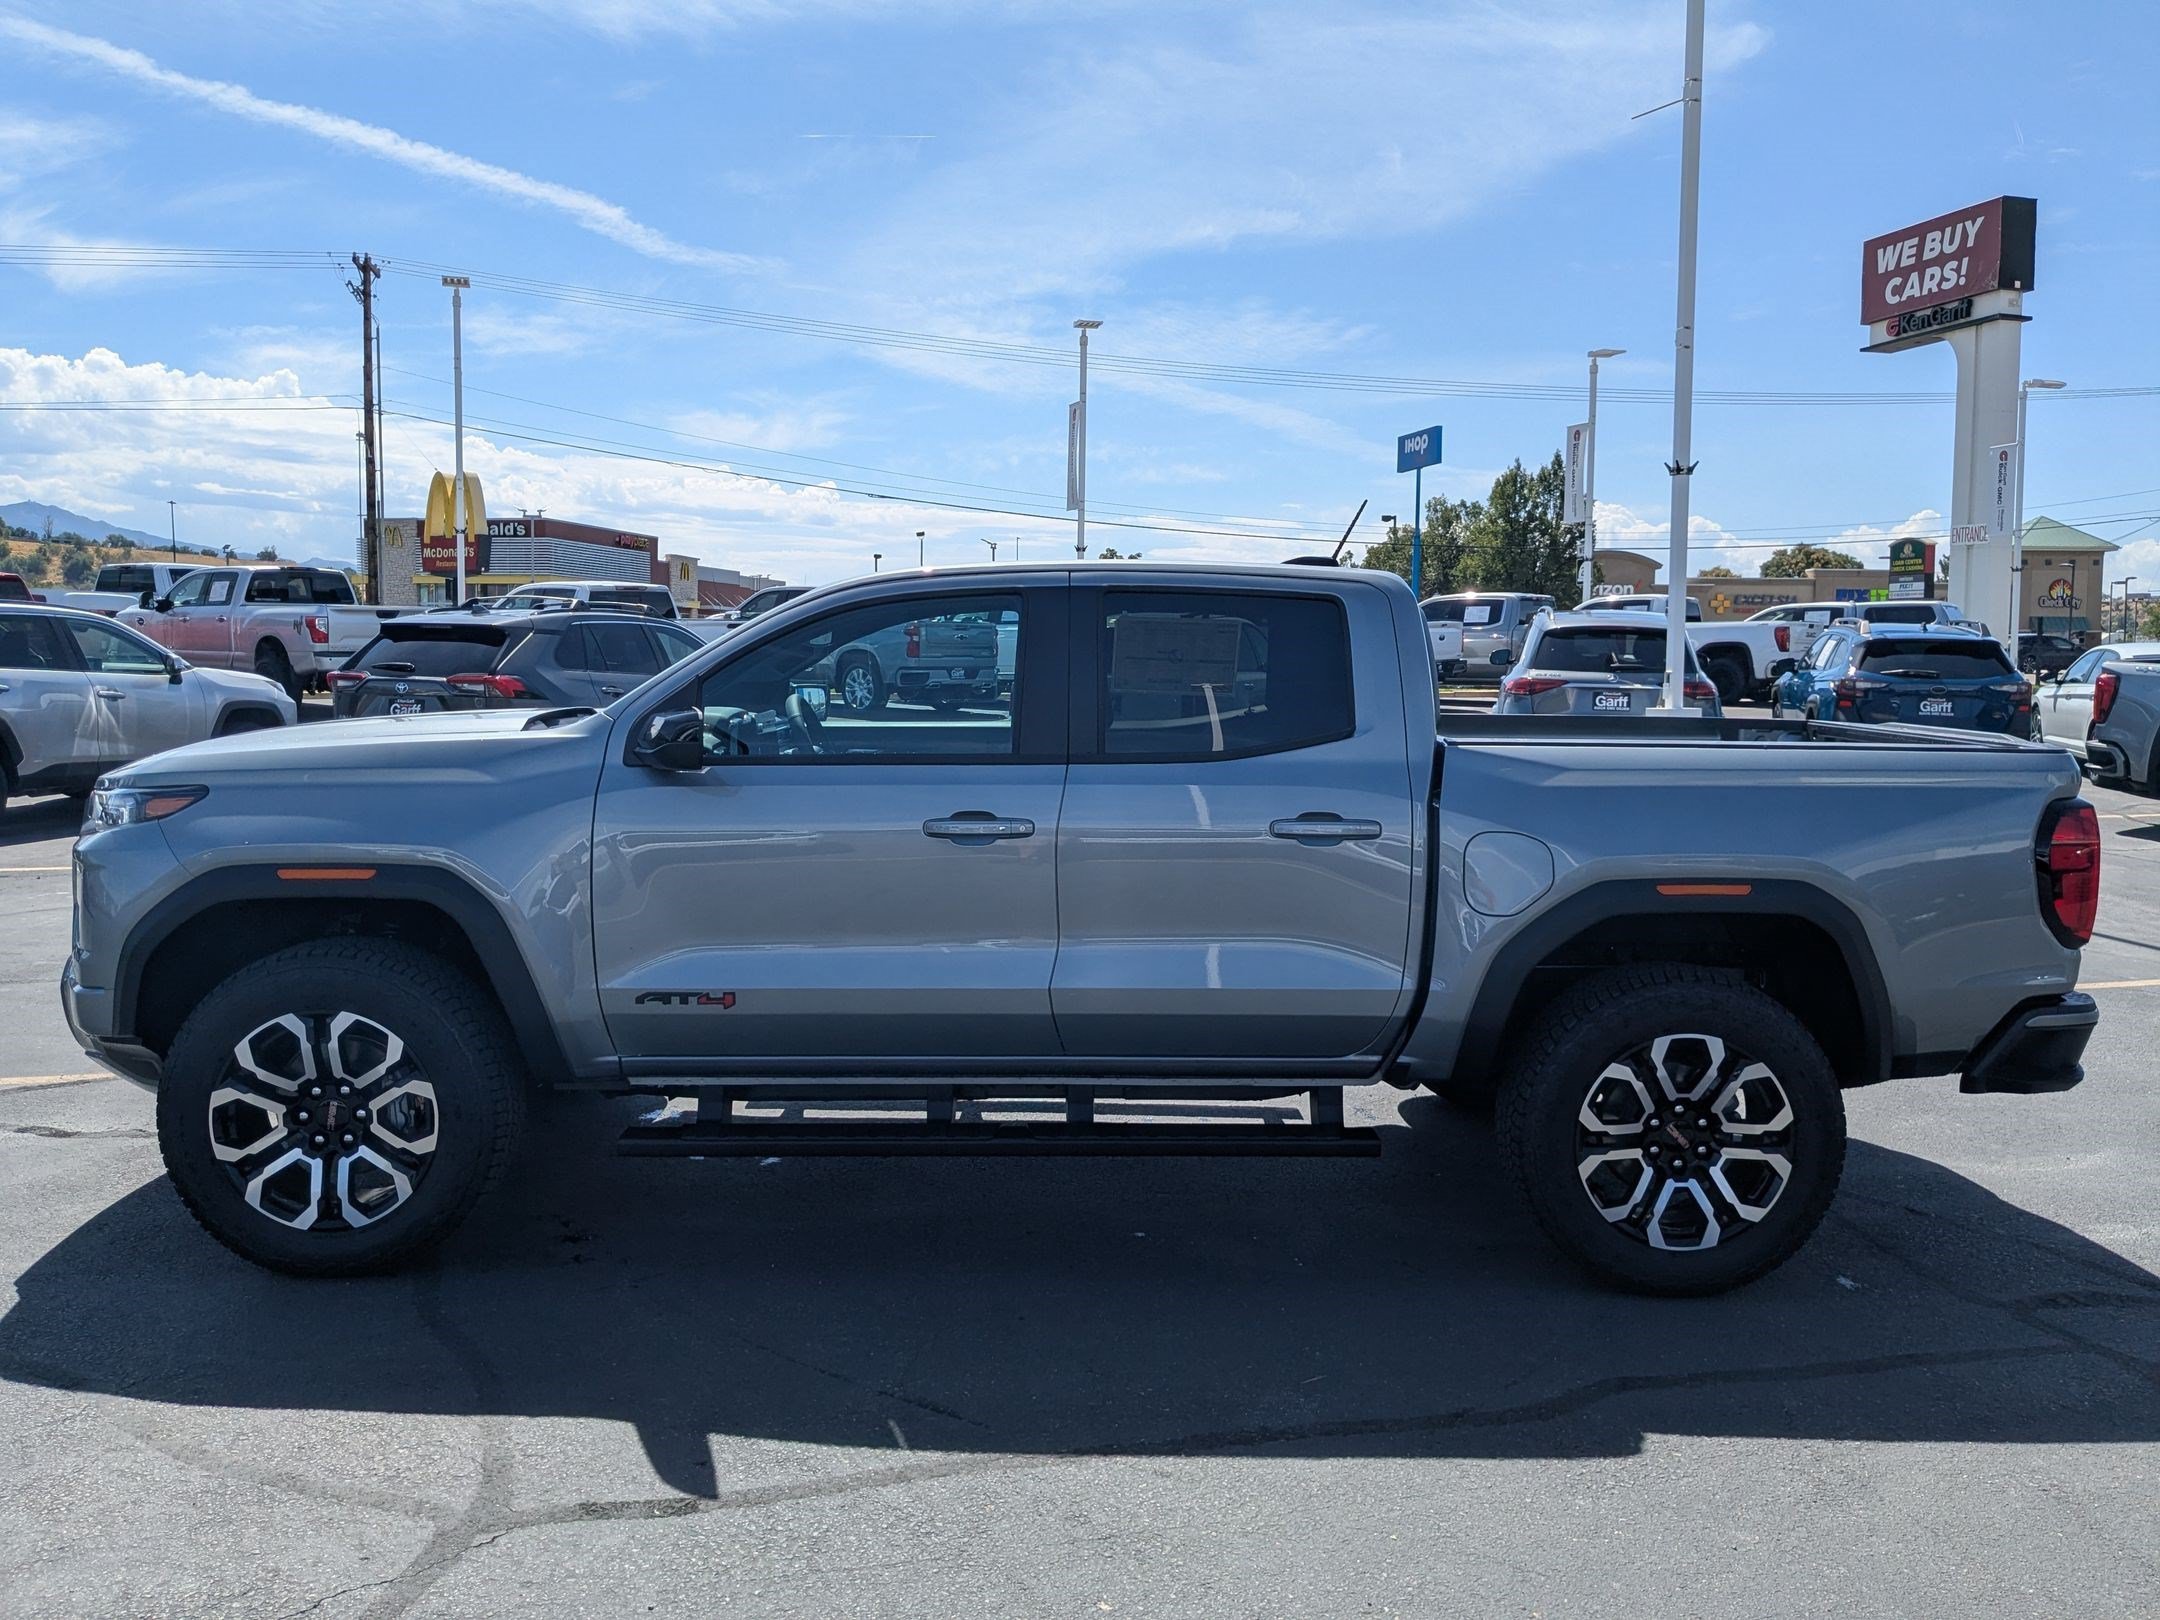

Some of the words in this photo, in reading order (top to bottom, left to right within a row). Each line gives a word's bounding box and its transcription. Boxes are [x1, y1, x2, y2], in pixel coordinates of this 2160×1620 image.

[1877, 237, 1920, 274] WE
[1923, 216, 1985, 260] BUY
[1885, 257, 1969, 304] CARS!
[1900, 314, 1928, 334] Ken
[1404, 433, 1429, 455] IHOP
[489, 522, 526, 536] ald's
[1952, 525, 1988, 544] ENTRANCE
[423, 547, 475, 558] McDond's
[1593, 583, 1634, 596] rizon
[1595, 695, 1629, 707] Garff
[1920, 700, 1952, 712] Garff
[390, 703, 421, 716] Garff
[635, 992, 736, 1010] AT4
